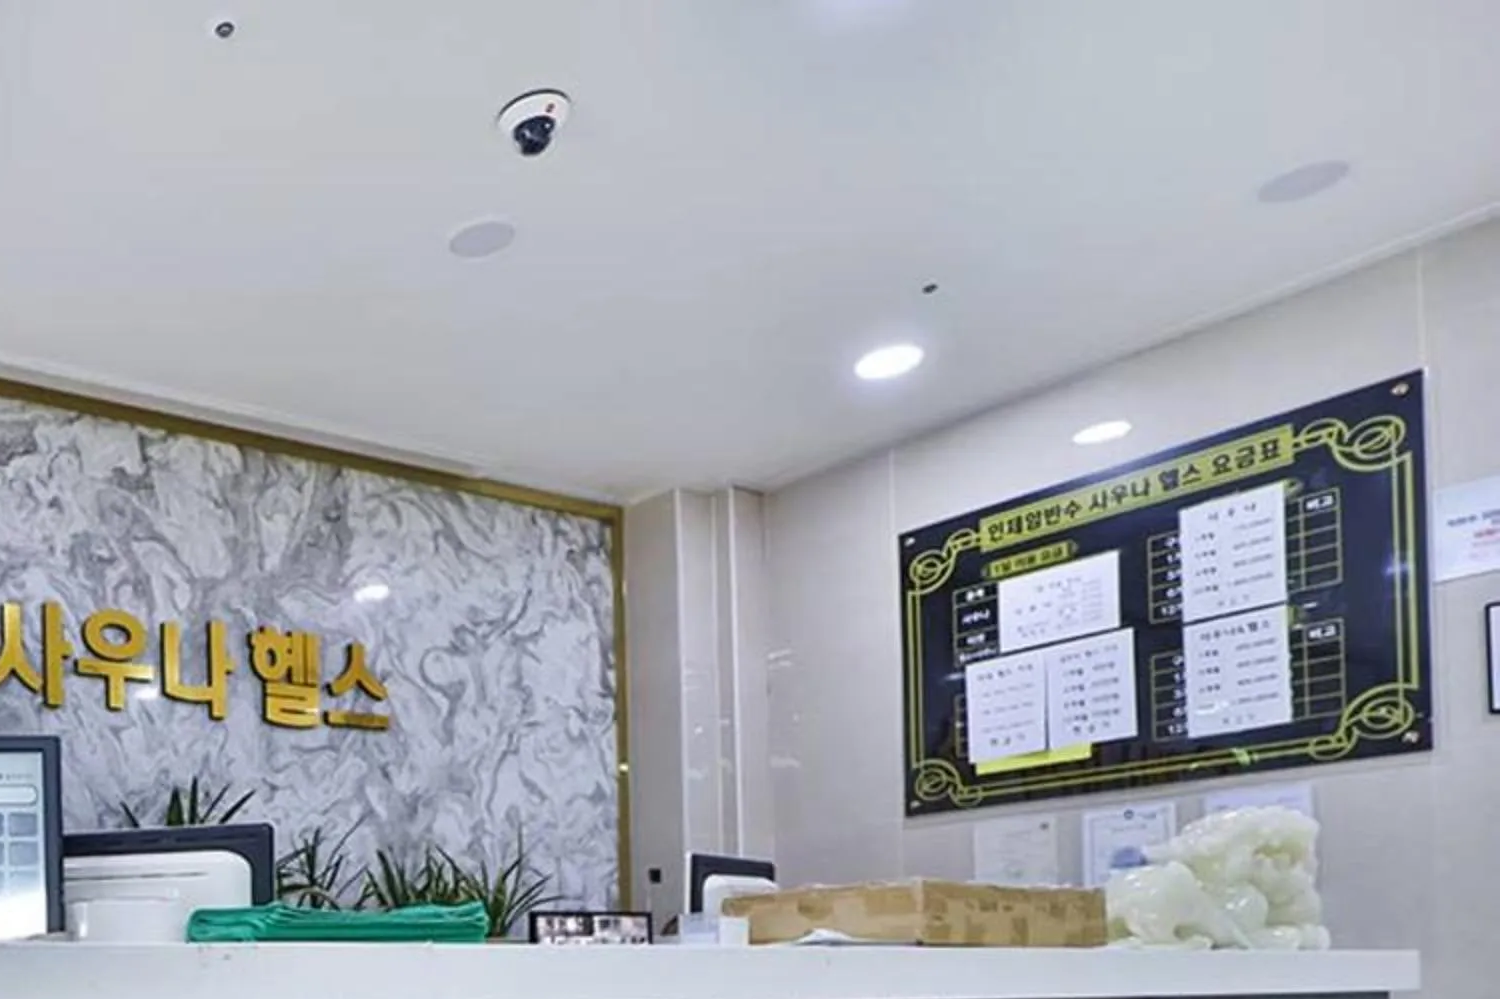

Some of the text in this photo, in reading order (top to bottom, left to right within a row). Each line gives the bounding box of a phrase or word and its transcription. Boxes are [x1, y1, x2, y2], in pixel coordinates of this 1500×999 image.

[1088, 477, 1152, 513] 사우나
[1158, 465, 1203, 493] 헬스
[1211, 437, 1282, 478] 요금표
[250, 629, 390, 727] 헬스
